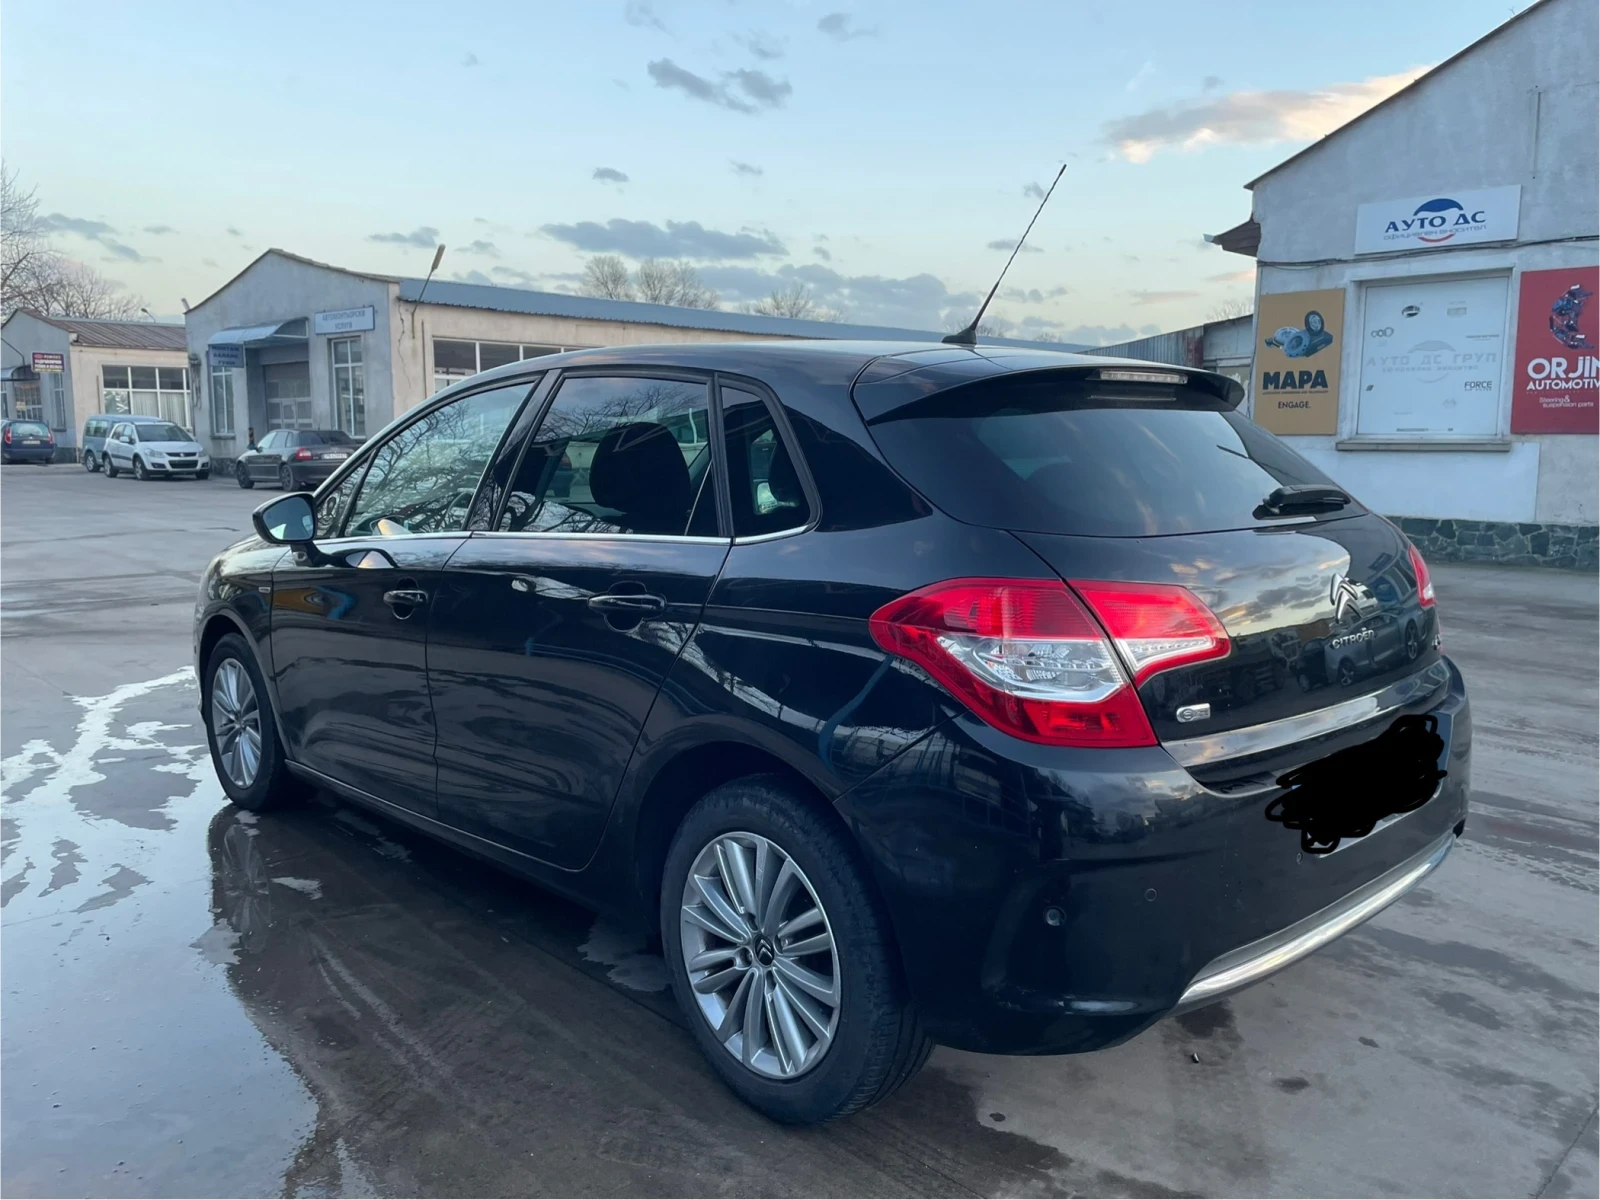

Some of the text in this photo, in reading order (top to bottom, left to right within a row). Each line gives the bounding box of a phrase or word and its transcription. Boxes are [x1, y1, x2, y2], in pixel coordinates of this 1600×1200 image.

[1385, 211, 1486, 233] АУТО ДС
[1366, 355, 1410, 367] АУТО
[1453, 352, 1497, 364] ГРУП
[1262, 370, 1328, 390] MAPA
[1464, 381, 1492, 389] FORCE
[1332, 627, 1375, 649] CITROËN
